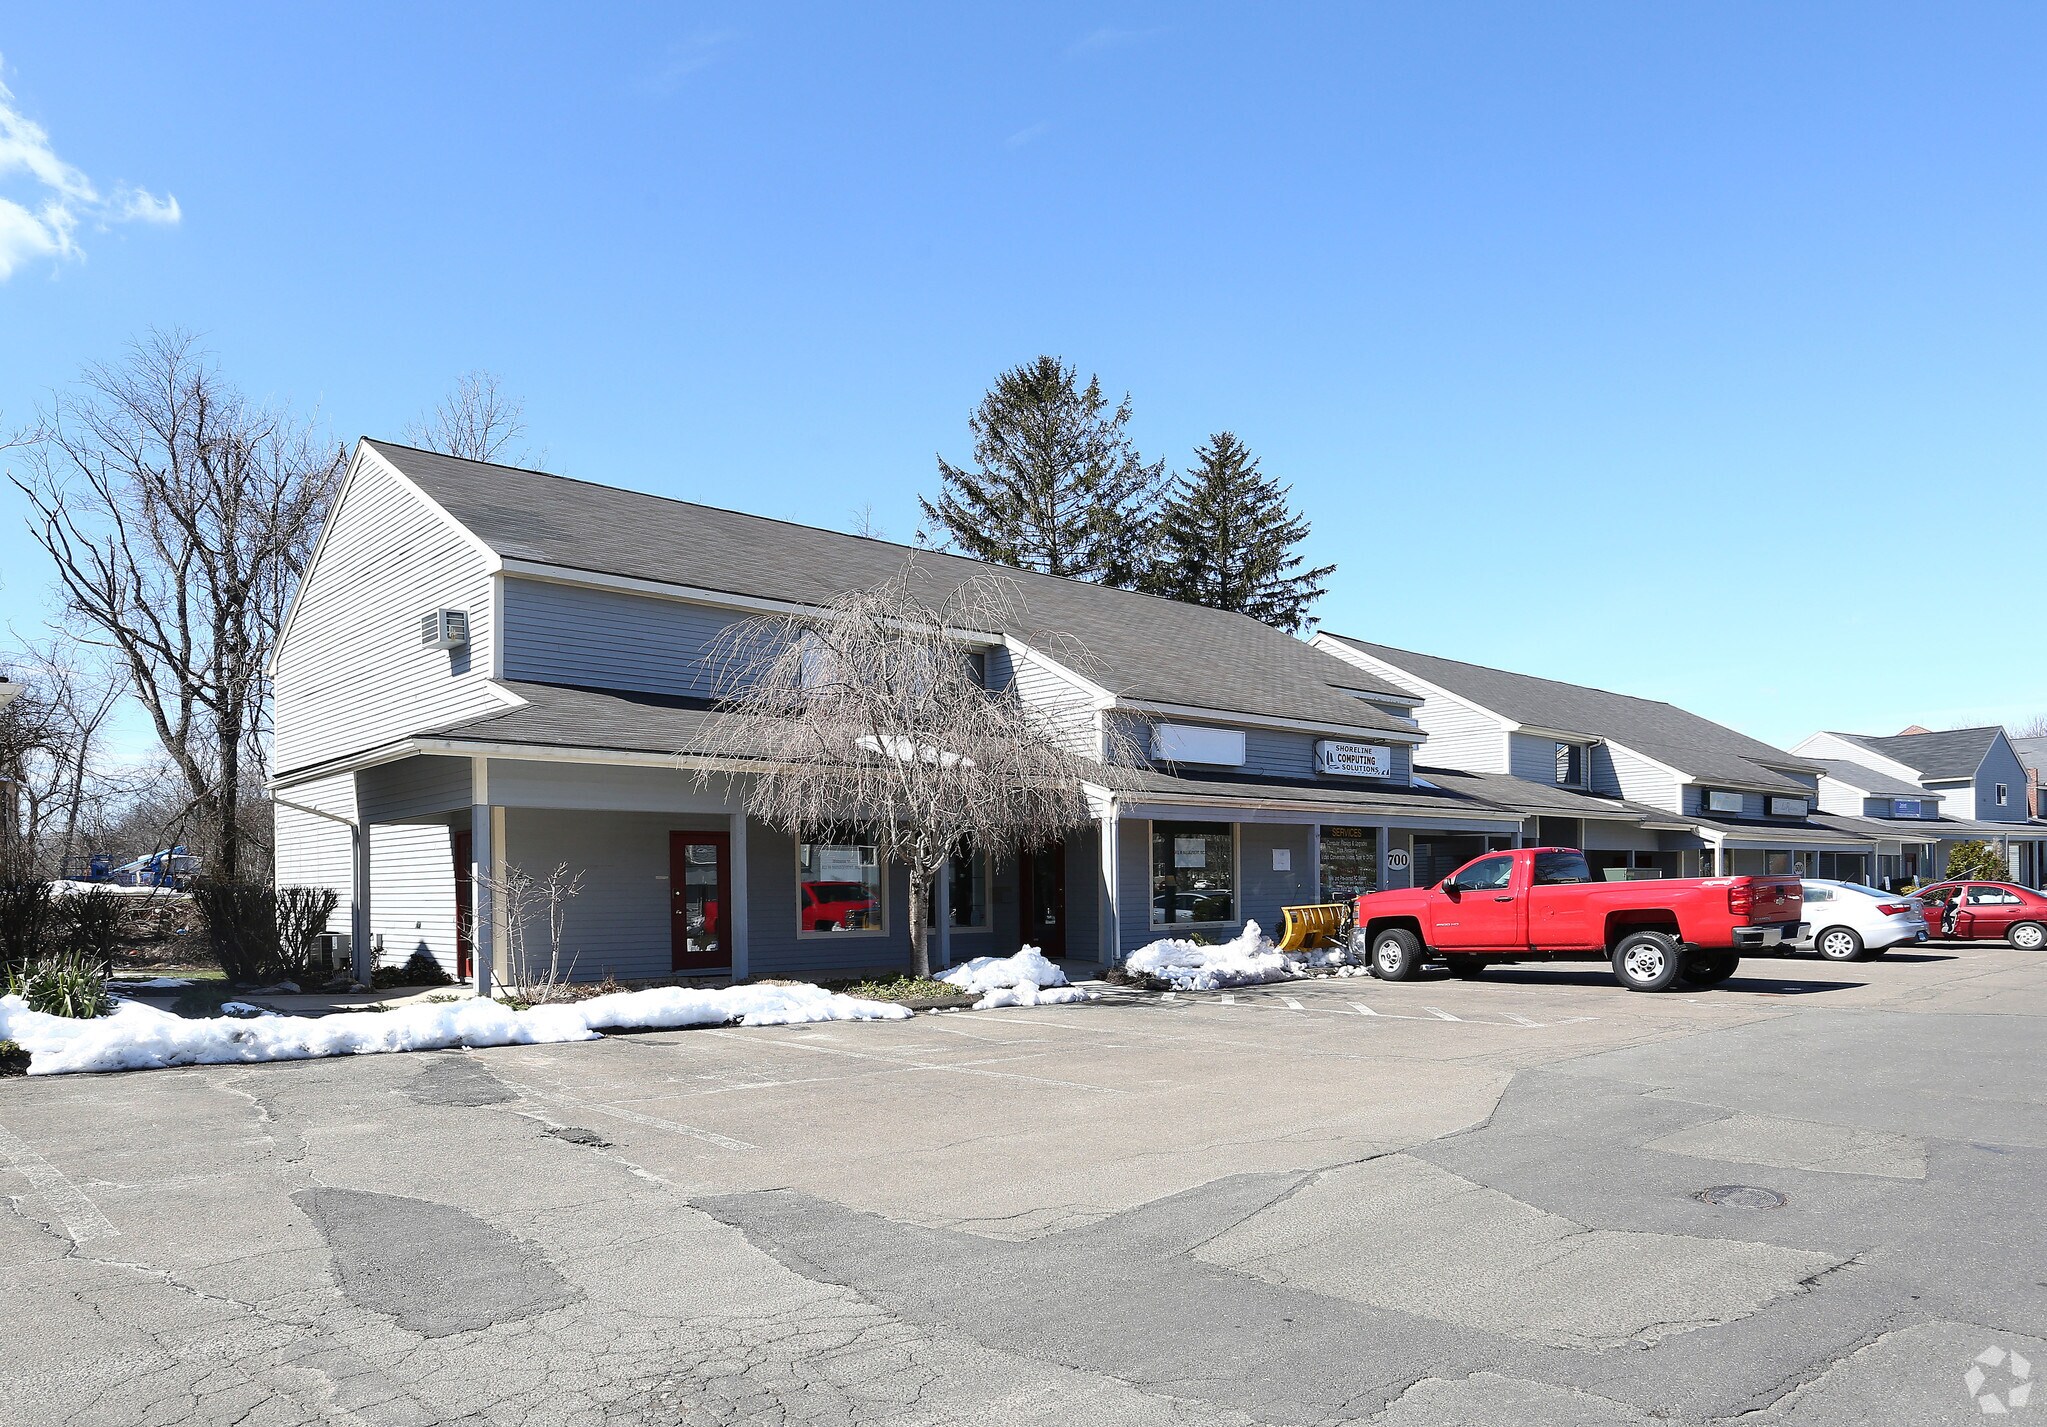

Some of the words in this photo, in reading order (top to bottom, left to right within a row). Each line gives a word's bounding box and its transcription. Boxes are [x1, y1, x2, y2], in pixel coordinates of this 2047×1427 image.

[1335, 745, 1373, 754] SHORELINE
[1337, 754, 1376, 765] COMPUTING
[1341, 764, 1379, 773] SOLUTIONS
[1331, 828, 1362, 837] SERVICES
[1388, 854, 1408, 866] 700
